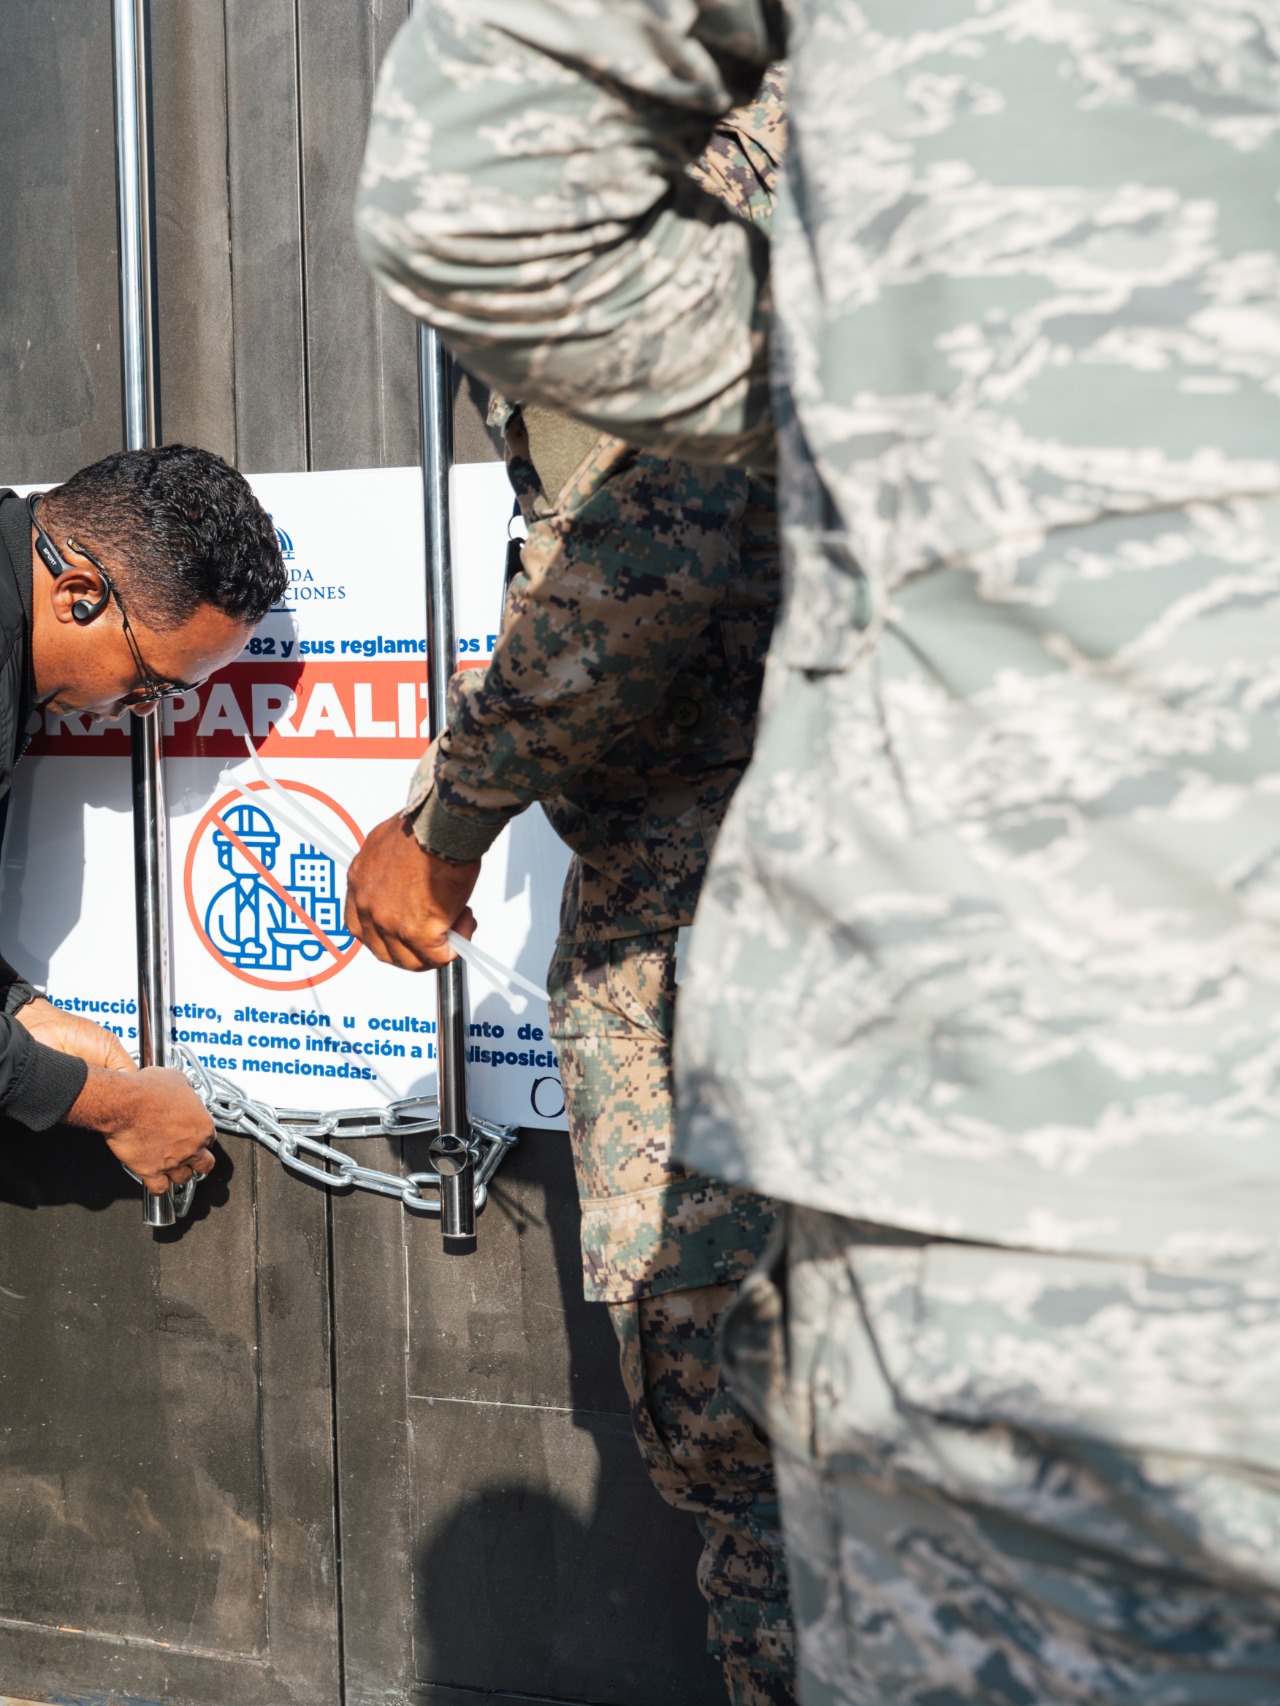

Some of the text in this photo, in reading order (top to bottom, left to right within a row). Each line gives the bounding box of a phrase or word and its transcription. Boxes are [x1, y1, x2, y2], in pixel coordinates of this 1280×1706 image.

[42, 547, 57, 566] SPORT
[290, 569, 315, 582] DA
[280, 586, 346, 600] CIONES
[280, 640, 295, 658] y
[299, 640, 335, 655] sus
[161, 682, 429, 738] PARALI
[46, 994, 137, 1015] estrucció
[170, 1003, 223, 1023] etiro,
[233, 1006, 331, 1027] alteración
[343, 1016, 355, 1029] u
[517, 1023, 544, 1042] de
[171, 1027, 243, 1046] tomada
[247, 1035, 301, 1051] como
[305, 1035, 406, 1058] infracción
[410, 1046, 422, 1059] a
[242, 1058, 378, 1081] mencionadas.
